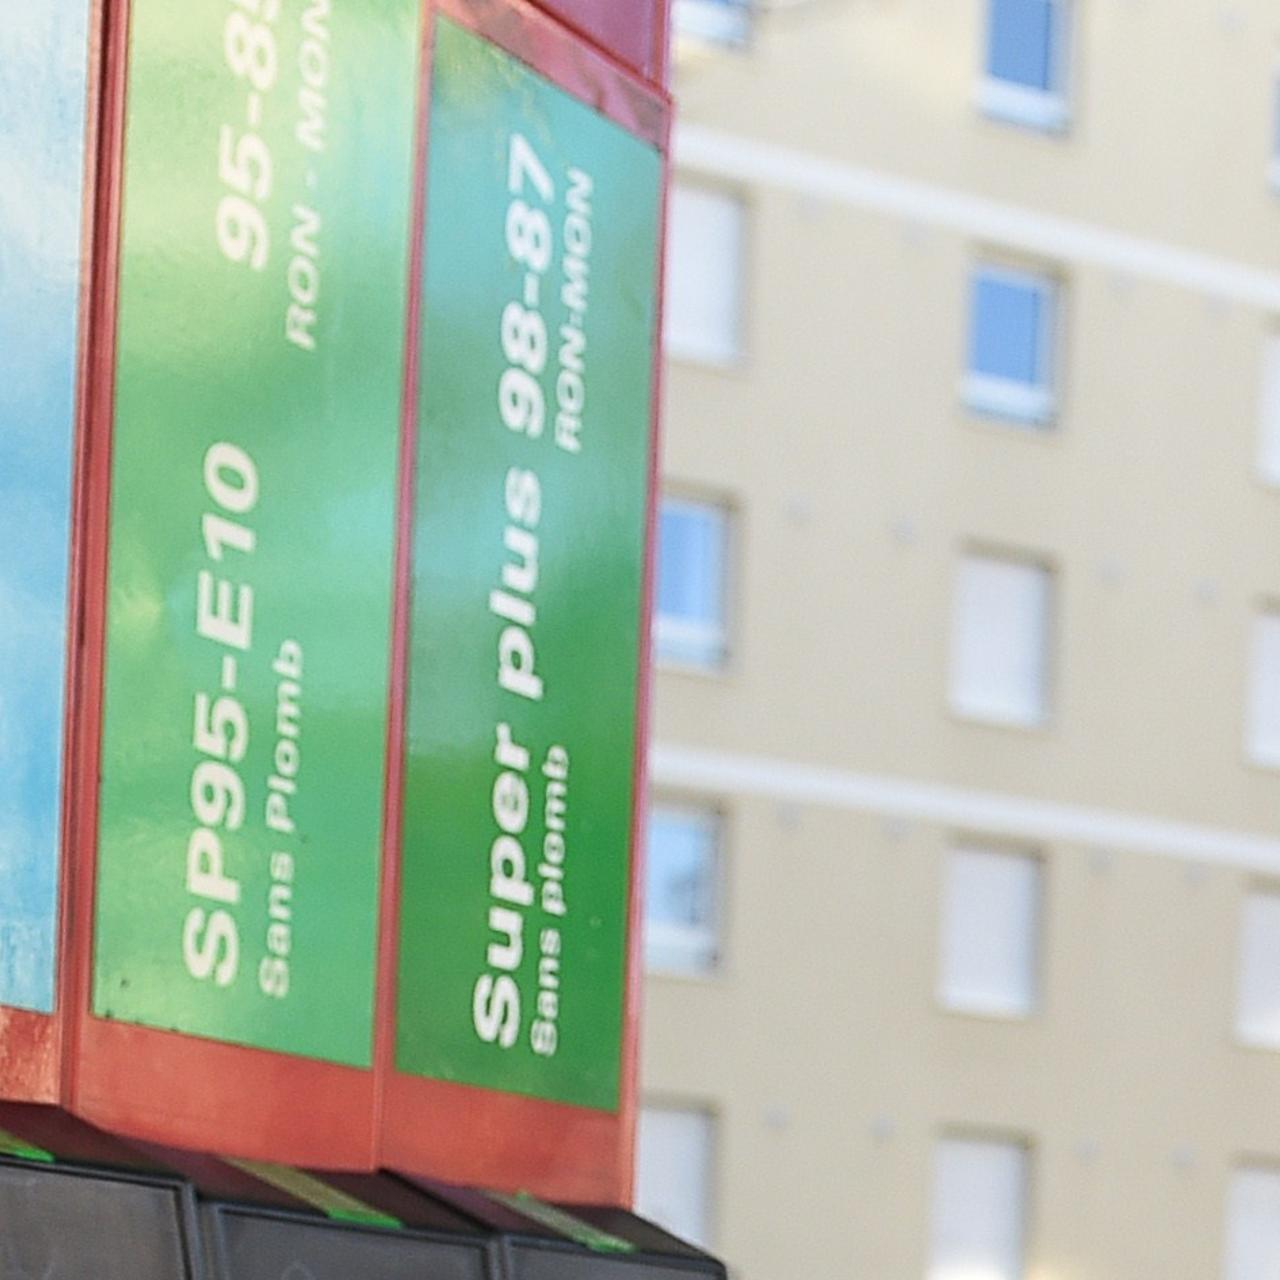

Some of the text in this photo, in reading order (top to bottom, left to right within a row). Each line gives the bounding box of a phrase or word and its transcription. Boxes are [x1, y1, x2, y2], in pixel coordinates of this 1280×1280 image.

[286, 203, 321, 350] RON
[554, 166, 593, 454] RON-MON
[472, 133, 555, 1049] Super plus 98-87
[258, 638, 301, 999] Sans Plomb
[530, 744, 569, 1057] Sans plomb
